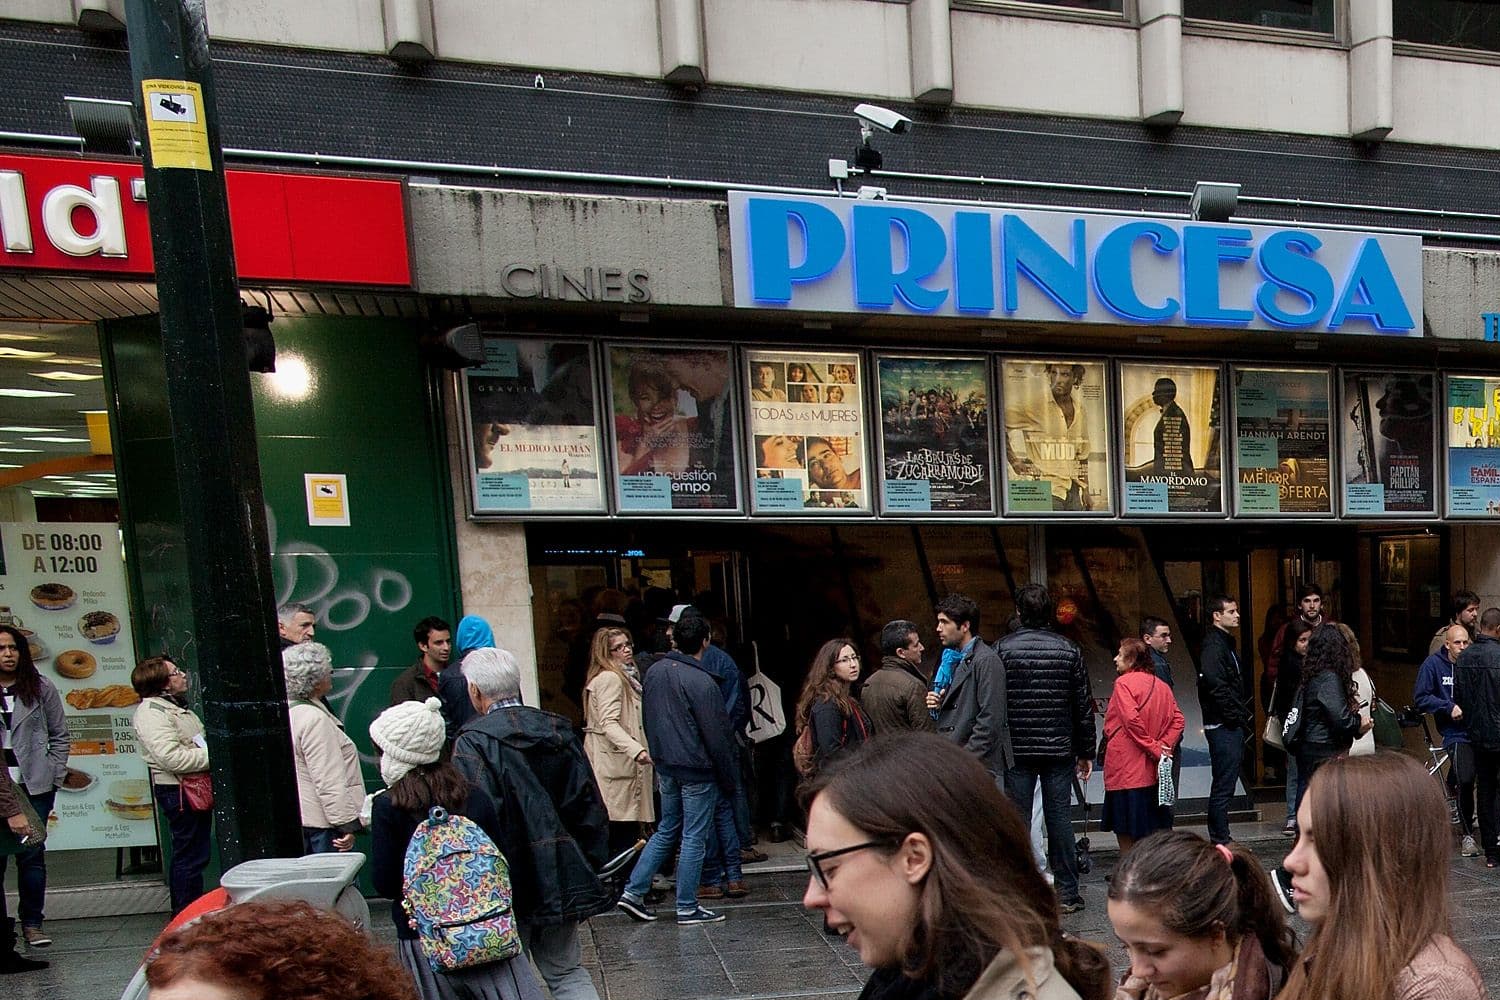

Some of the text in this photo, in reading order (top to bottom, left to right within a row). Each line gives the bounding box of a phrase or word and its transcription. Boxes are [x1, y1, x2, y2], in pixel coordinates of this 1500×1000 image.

[746, 196, 1416, 331] PRINCESA
[501, 262, 652, 303] CINES
[752, 407, 858, 424] TODAS LAS MUJERES
[1240, 431, 1327, 440] HANNAH ARENDT
[500, 443, 513, 453] EL
[1040, 443, 1076, 460] MUD
[904, 448, 974, 466] LAS BRUJAS DE
[664, 468, 717, 480] cuestión
[894, 461, 984, 482] ZUGARRAMURDI
[1390, 465, 1420, 477] CAPITÁN
[671, 481, 711, 494] empo
[1140, 475, 1208, 486] MAYORDOMO
[1390, 477, 1420, 489] PHILLIPS
[1279, 485, 1328, 500] OFERTA
[21, 533, 102, 551] DE 08:00
[33, 556, 98, 573] A 12:00
